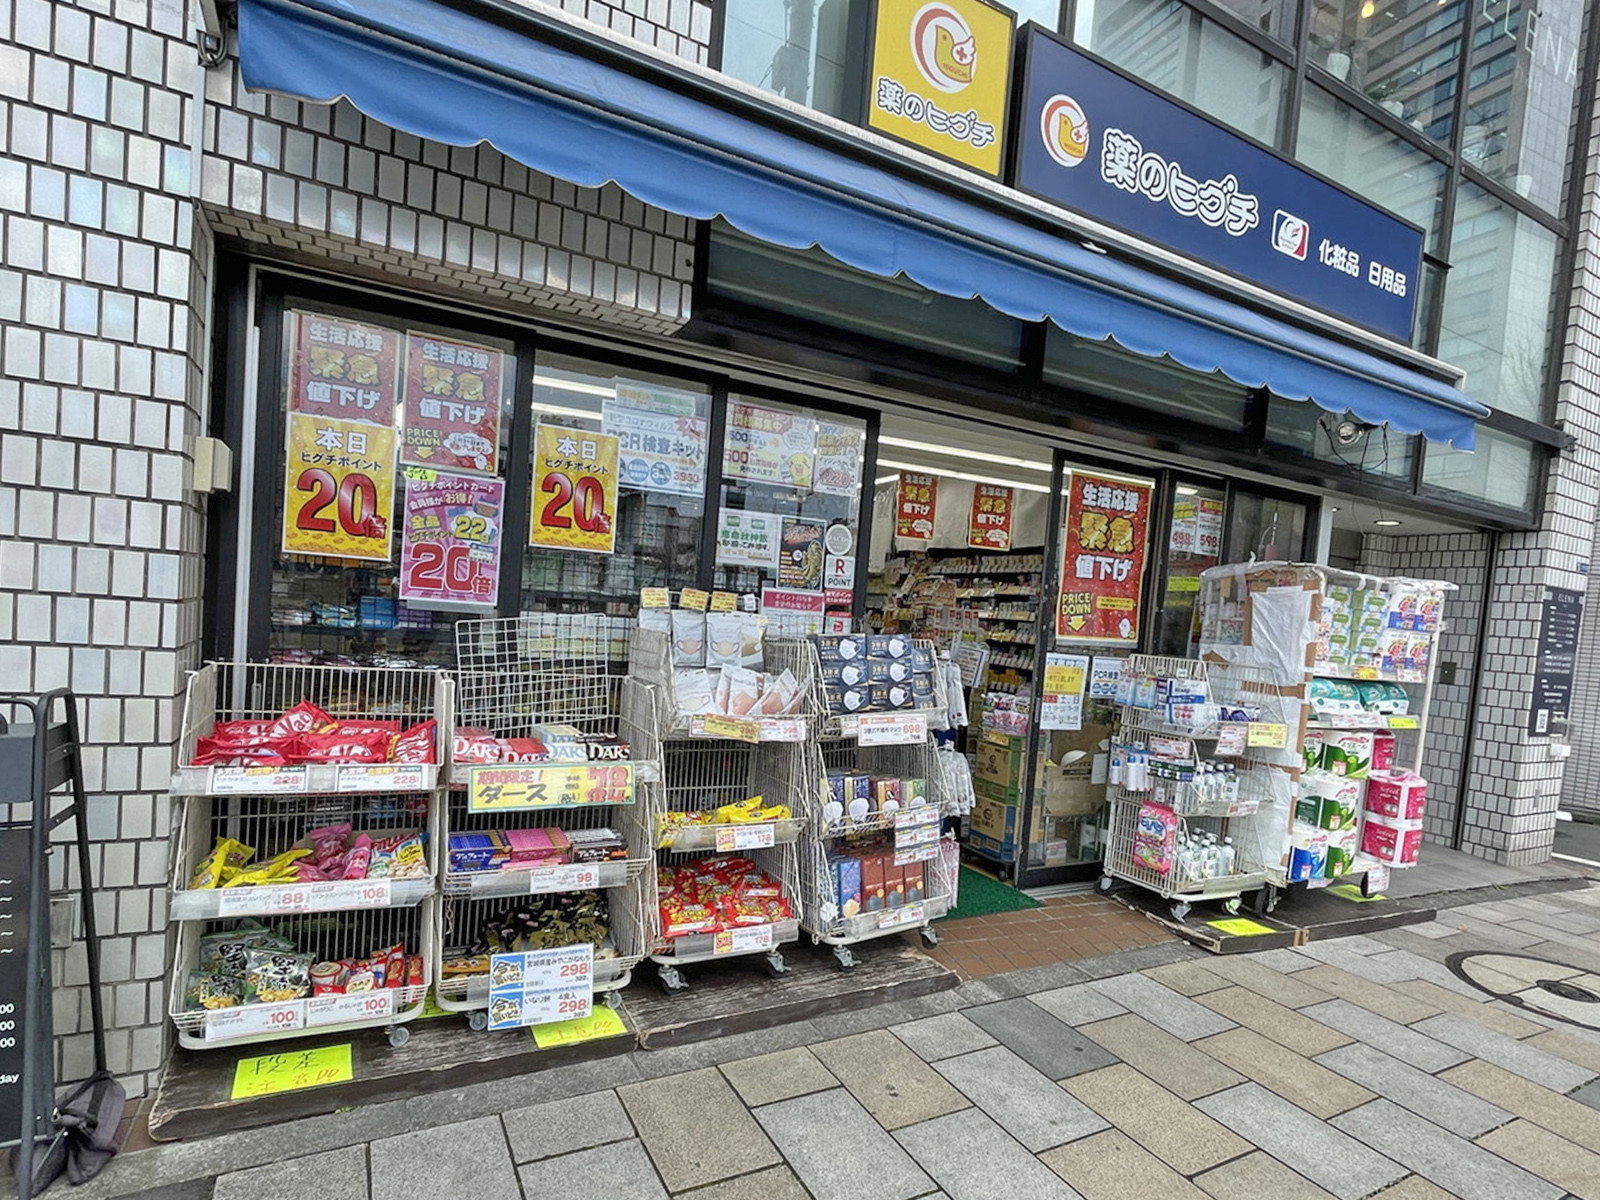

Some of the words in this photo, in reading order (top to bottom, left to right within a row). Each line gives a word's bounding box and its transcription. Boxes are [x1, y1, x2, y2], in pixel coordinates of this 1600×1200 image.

[876, 77, 995, 149] 薬のヒグチ
[1102, 129, 1259, 236] 薬のヒグチ
[1319, 238, 1360, 278] 化粧品
[1368, 263, 1407, 298] 日用品
[309, 322, 384, 352] 生活応援
[307, 344, 380, 386] 緊急
[422, 342, 490, 371] 生活応援
[421, 363, 487, 403] 緊急
[306, 380, 381, 410] 値下げ
[419, 397, 487, 425] 値下げ
[316, 427, 368, 455] 本日
[406, 428, 440, 438] PRICE
[407, 437, 441, 446] DOWN
[556, 436, 598, 461] 本日
[301, 452, 382, 471] ヒグチポイント
[545, 458, 608, 475] ヒグチポイント
[411, 481, 496, 494] ヒグチポイントカード
[1082, 483, 1140, 513] 生活応援
[410, 515, 441, 531] 全品
[1079, 511, 1135, 555] 緊急
[836, 558, 846, 574] R
[1075, 554, 1133, 582] 値下げ
[827, 577, 851, 586] POINT
[1062, 593, 1091, 604] PRICE
[1062, 604, 1092, 615] DOWN
[903, 724, 921, 734] 698
[453, 738, 500, 760] DARS
[588, 743, 630, 760] DARS
[273, 775, 300, 785] 228
[393, 775, 417, 785] 228
[478, 783, 548, 804] ダース
[576, 872, 592, 883] 98
[282, 893, 303, 905] 88
[362, 887, 385, 899] 108
[560, 962, 588, 977] 298
[364, 997, 388, 1011] 100
[558, 998, 587, 1013] 298
[270, 1010, 295, 1024] 100
